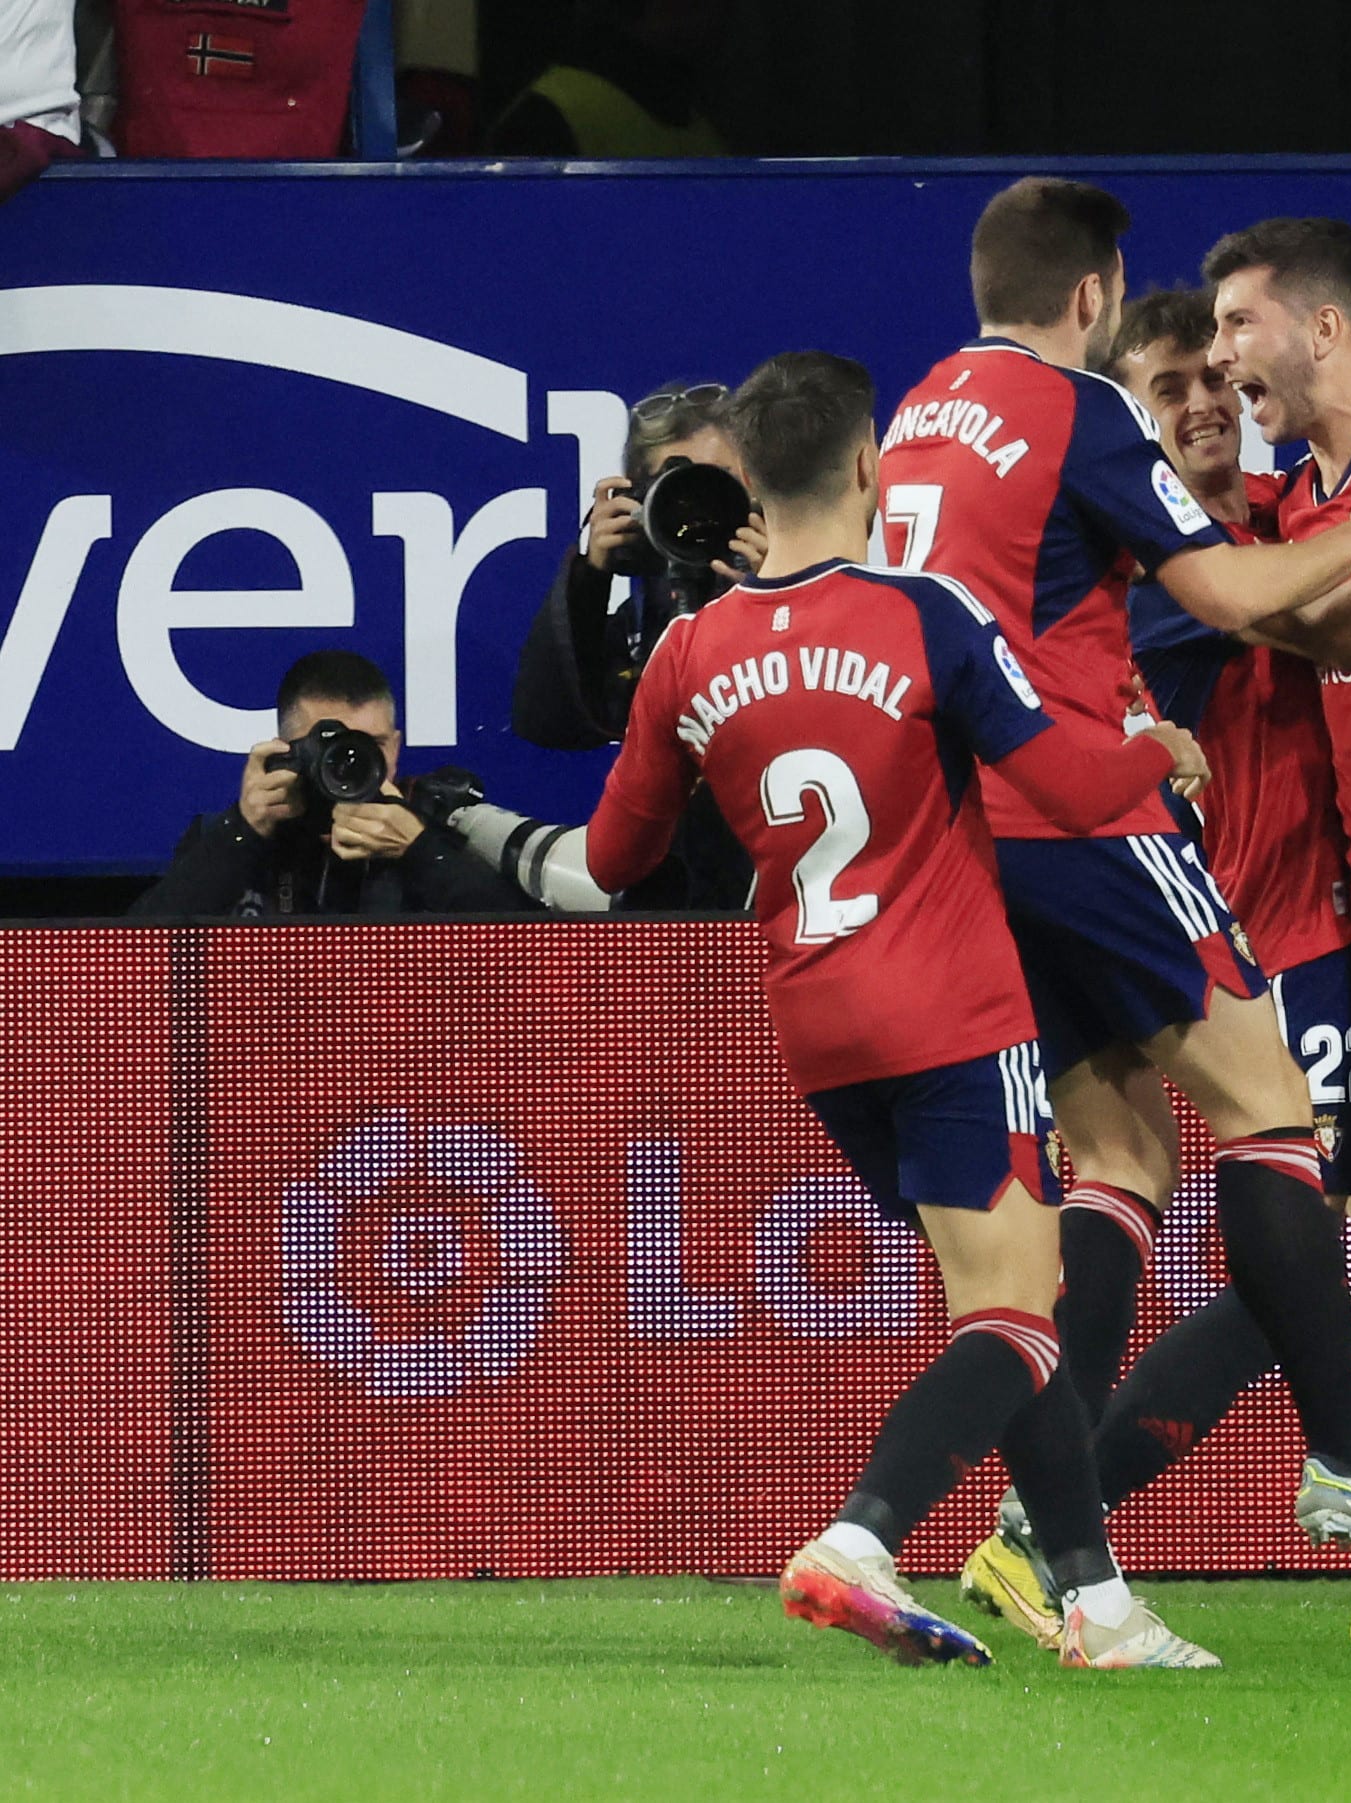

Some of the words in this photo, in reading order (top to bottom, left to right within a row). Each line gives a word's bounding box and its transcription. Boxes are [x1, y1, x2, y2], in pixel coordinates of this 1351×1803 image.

[879, 399, 1030, 479] ONCAYOLA
[886, 484, 944, 573] 7
[677, 651, 789, 755] NACHO
[799, 647, 912, 721] VIDAL
[760, 748, 878, 945] 2
